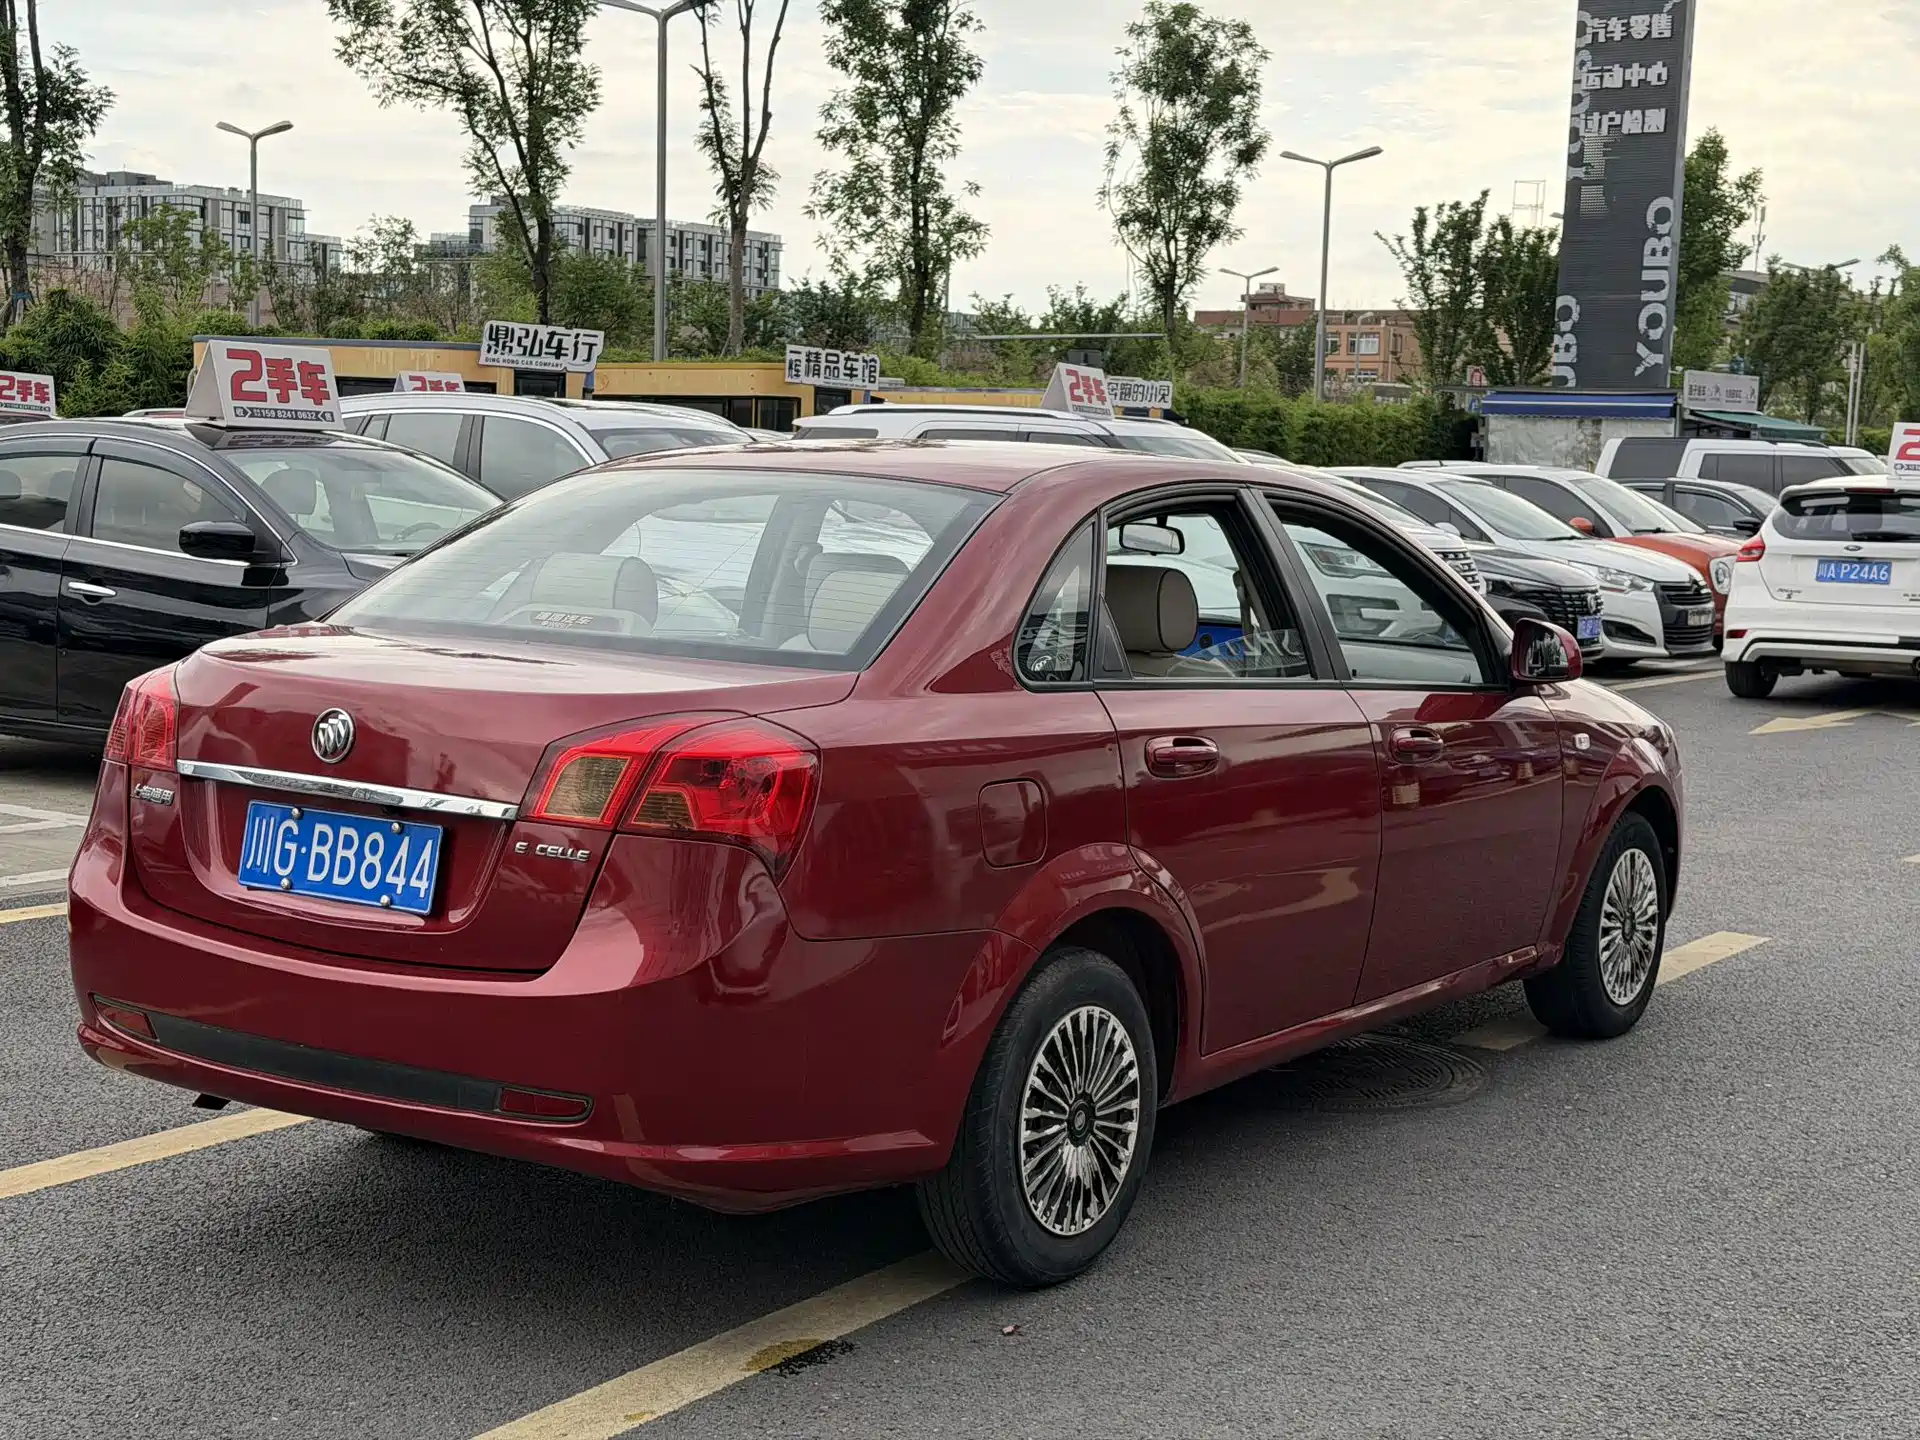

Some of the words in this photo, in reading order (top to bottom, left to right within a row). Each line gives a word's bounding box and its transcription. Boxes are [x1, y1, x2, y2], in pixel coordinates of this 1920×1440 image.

[1586, 13, 1673, 43] 汽车零售
[1580, 61, 1669, 90] 运动中心
[1579, 108, 1667, 136] 过户检测
[1634, 196, 1674, 377] YOUBO
[486, 324, 599, 363] 鼎弘车行
[226, 348, 331, 406] 2手车
[534, 361, 564, 369] COMPANY
[1066, 368, 1107, 406] 2手车
[535, 844, 591, 862] CELLE
